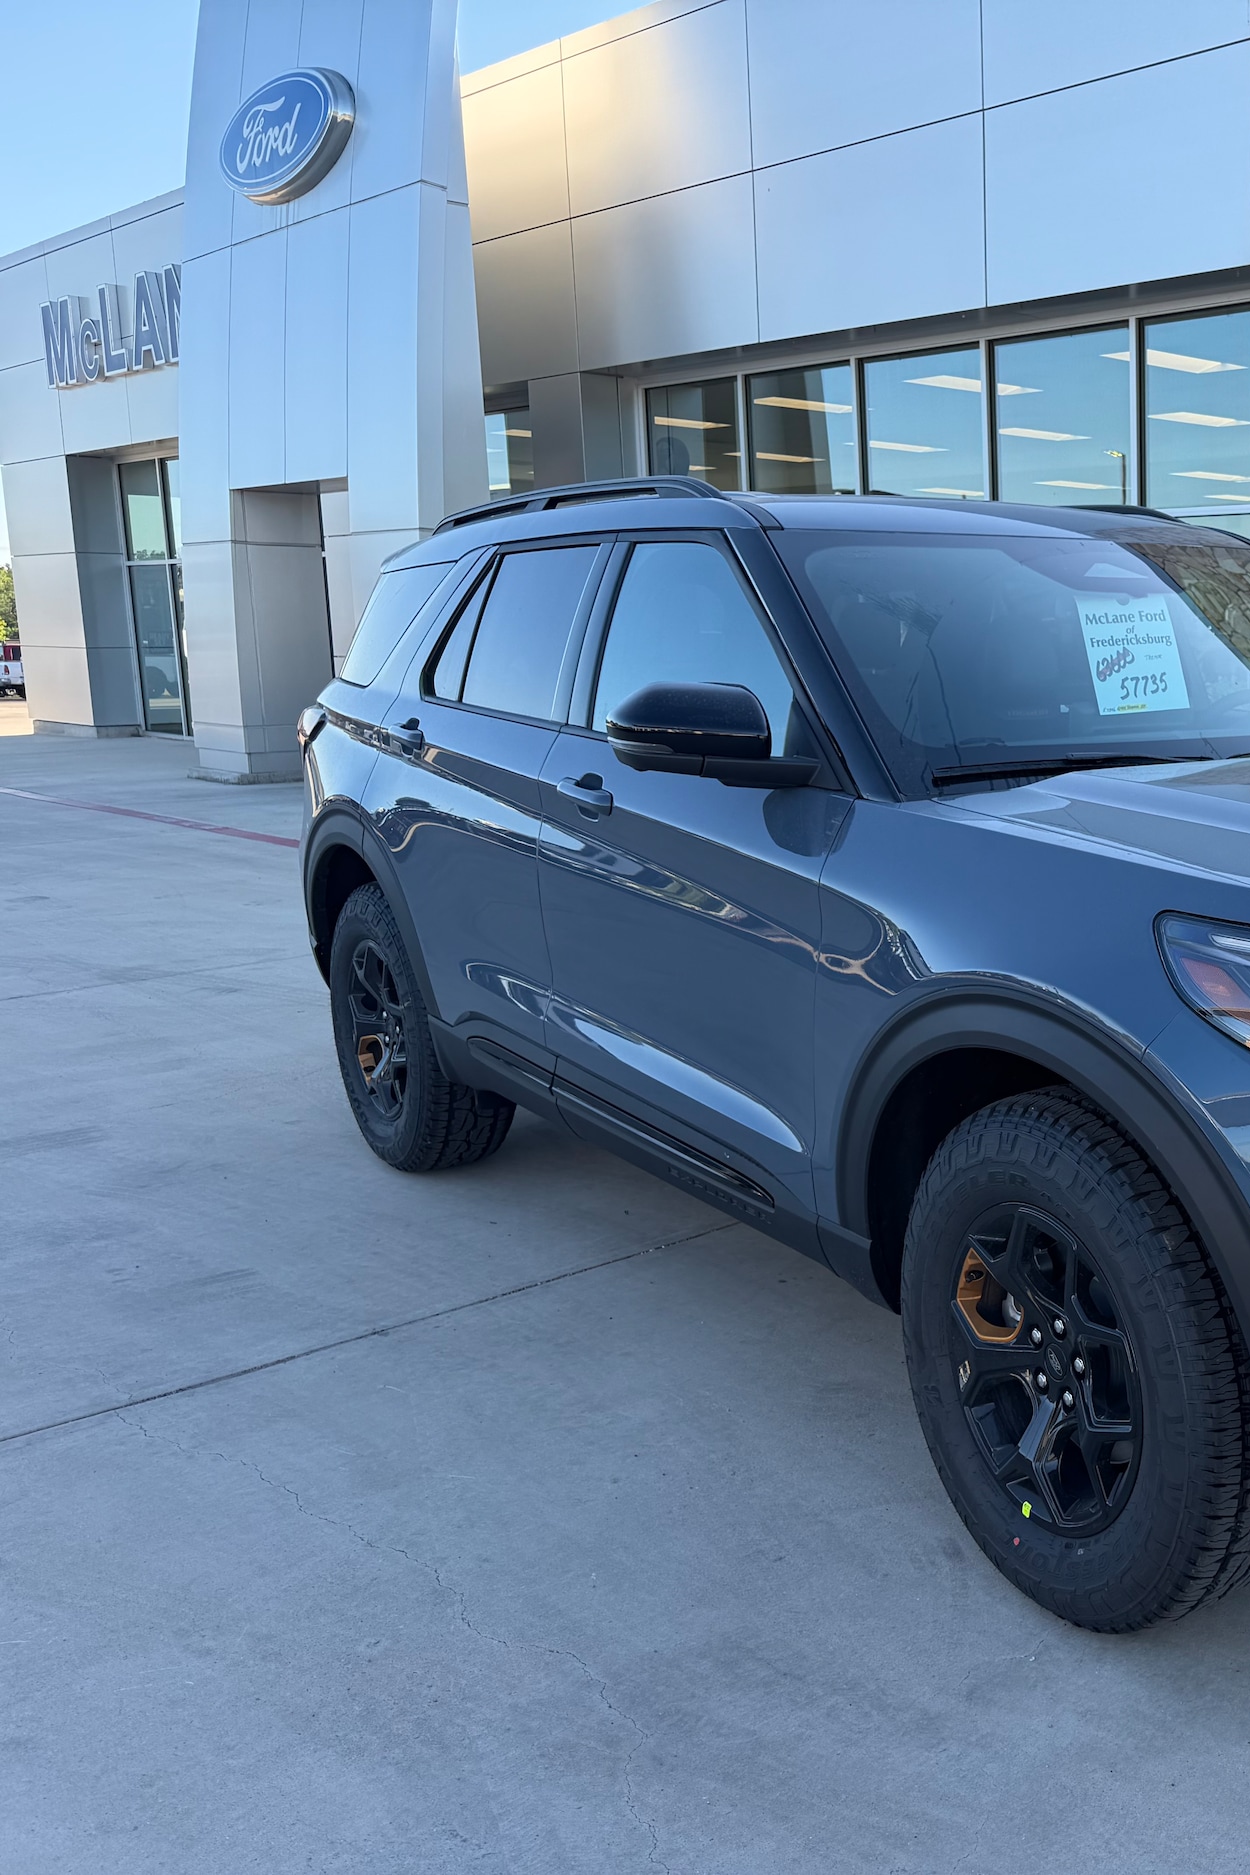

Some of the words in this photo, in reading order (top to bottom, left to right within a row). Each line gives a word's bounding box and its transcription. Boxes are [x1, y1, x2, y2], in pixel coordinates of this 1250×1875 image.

[236, 96, 302, 174] Ford
[1085, 612, 1136, 625] McLane
[1138, 610, 1167, 622] Ford
[1125, 625, 1135, 634] of
[1090, 634, 1172, 649] Fredericksburg
[1120, 671, 1168, 700] 57735
